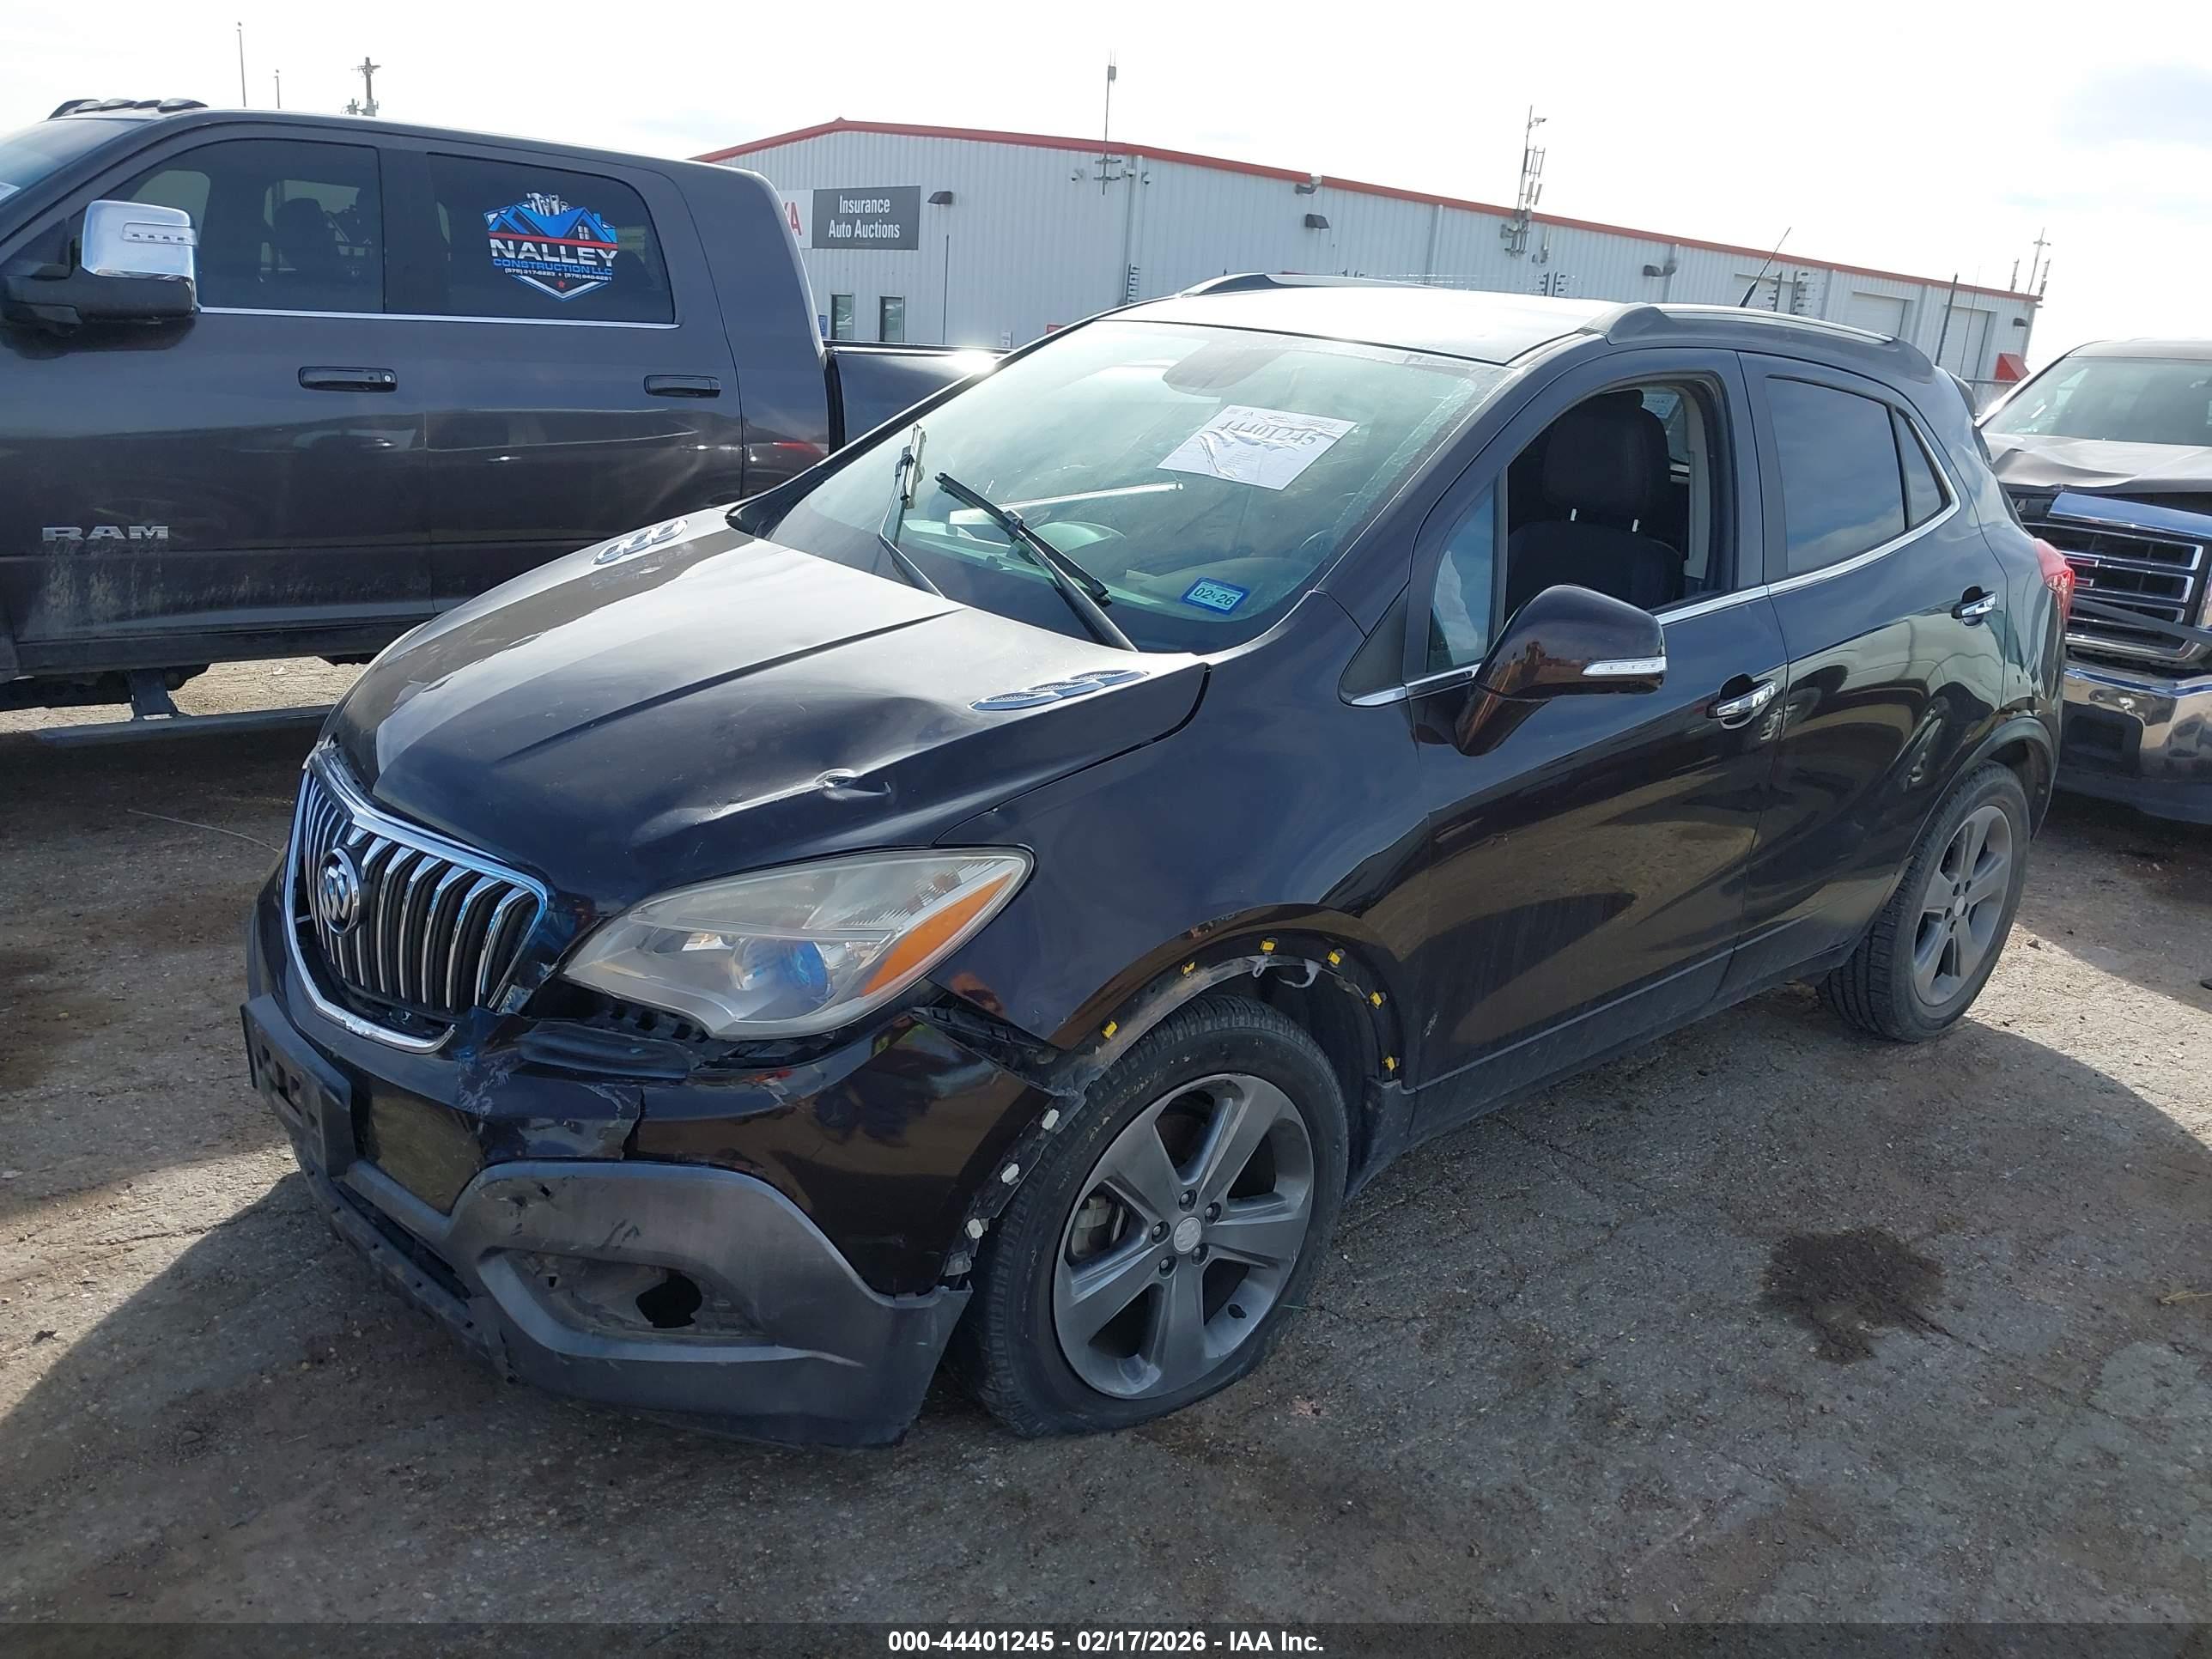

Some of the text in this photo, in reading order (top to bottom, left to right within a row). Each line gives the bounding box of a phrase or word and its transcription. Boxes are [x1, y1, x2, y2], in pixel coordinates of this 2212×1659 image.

[839, 195, 890, 214] Insurance
[829, 219, 900, 239] Auto Auctions
[489, 239, 618, 267] NALLEY
[493, 258, 613, 276] CONSTRUCTION LLC
[42, 526, 169, 542] RAM
